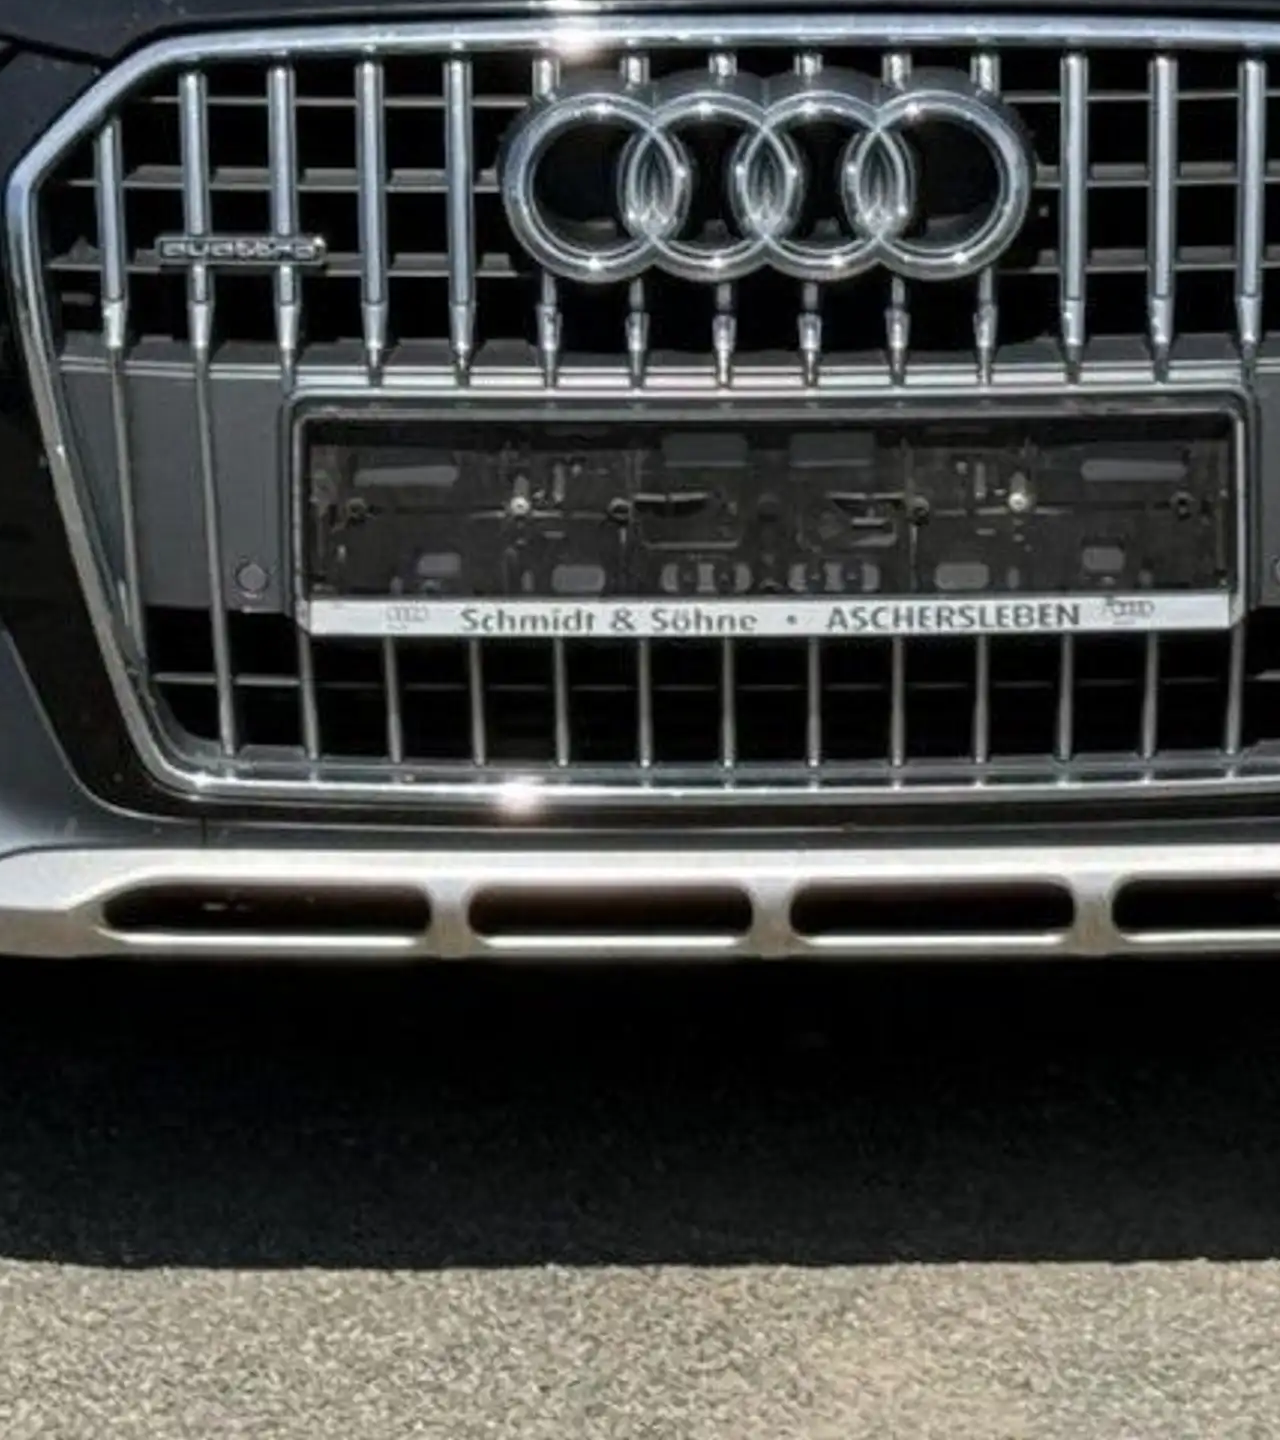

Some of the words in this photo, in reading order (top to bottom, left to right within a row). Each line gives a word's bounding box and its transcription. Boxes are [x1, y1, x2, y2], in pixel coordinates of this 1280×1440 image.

[460, 607, 596, 634] Schmidt
[609, 606, 636, 633] &
[650, 605, 758, 633] Söhne
[825, 602, 1081, 632] ASCHERSLEBEN
